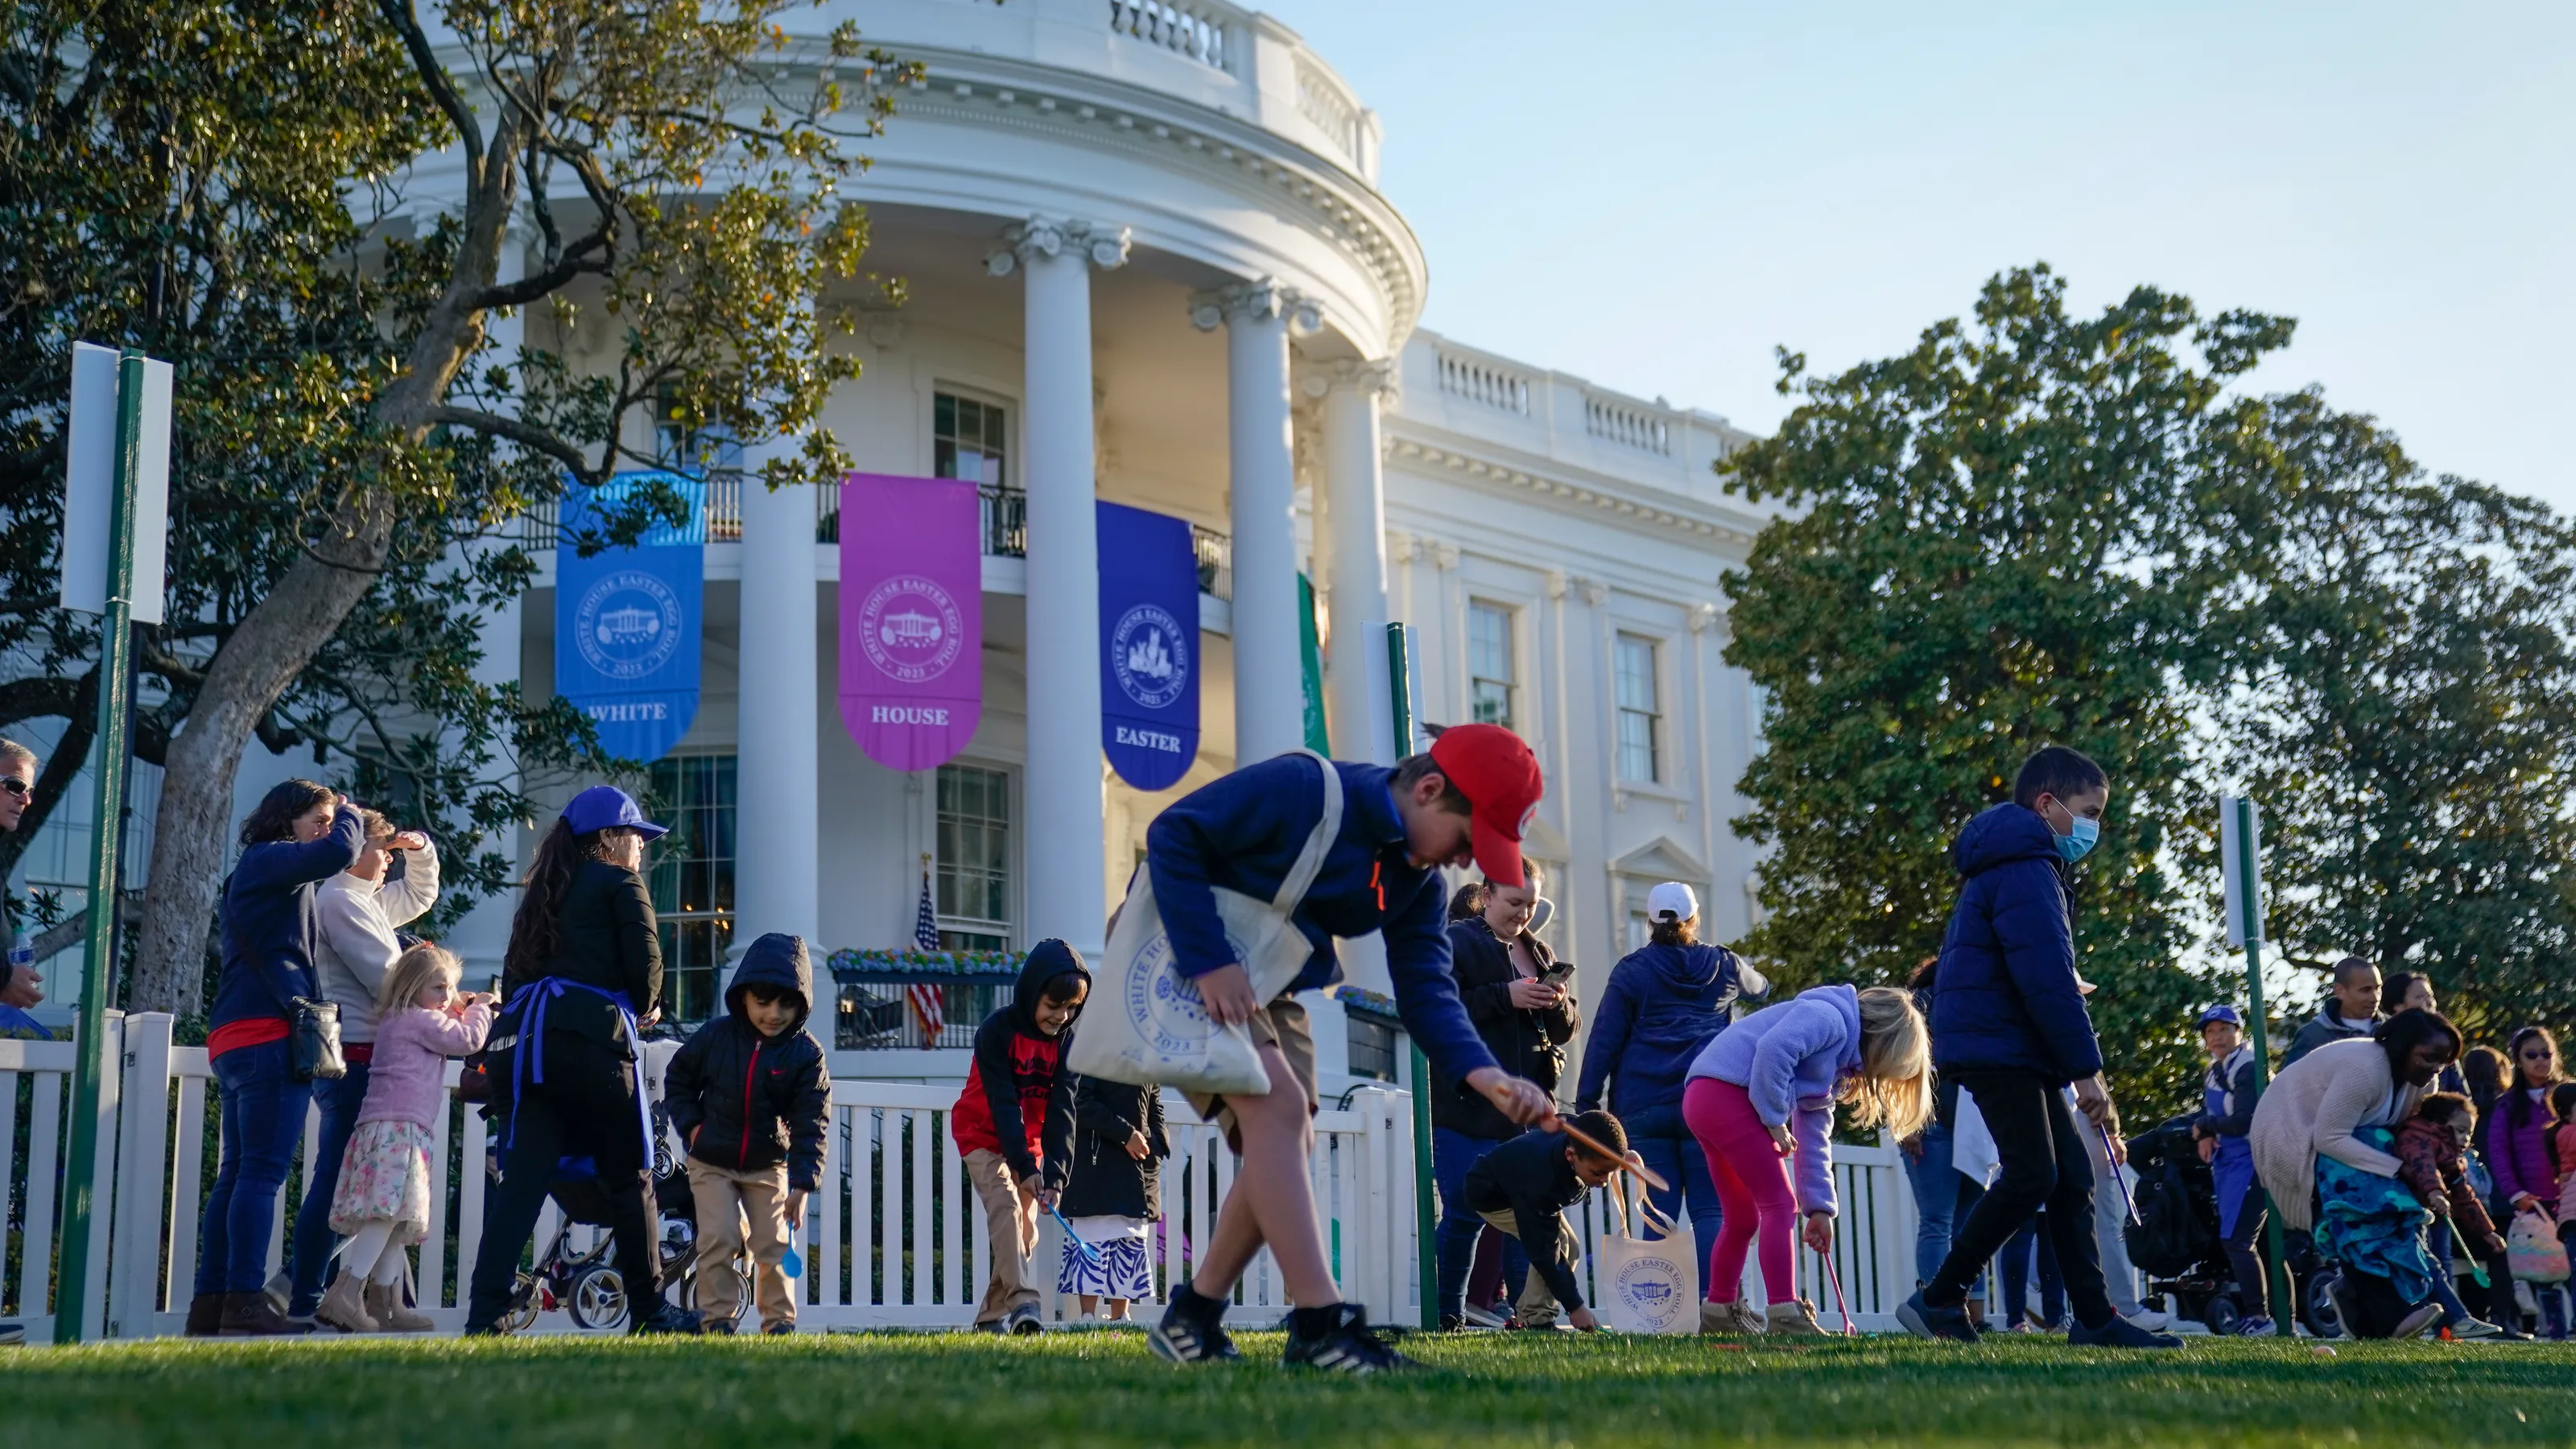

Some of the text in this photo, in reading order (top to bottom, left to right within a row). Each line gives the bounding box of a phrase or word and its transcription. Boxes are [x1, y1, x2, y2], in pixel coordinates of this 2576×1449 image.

[579, 575, 677, 665] WHITE HOUSE EASTER EGG ROLL
[863, 580, 958, 667] WHITE HOUSE EASTER EGG ROLL
[1117, 609, 1143, 642] HOUSE
[1144, 609, 1177, 637] EASTER
[613, 663, 643, 675] 2023
[896, 666, 925, 679] 2023
[588, 702, 667, 722] WHITE
[872, 706, 949, 725] HOUSE
[1116, 725, 1182, 753] EASTER
[1131, 963, 1150, 1024] WHITE
[1153, 1031, 1190, 1051] 2023
[1618, 1259, 1683, 1315] WHITE HOUSE EASTER EGG ROLL
[1646, 1316, 1664, 1327] 2023
